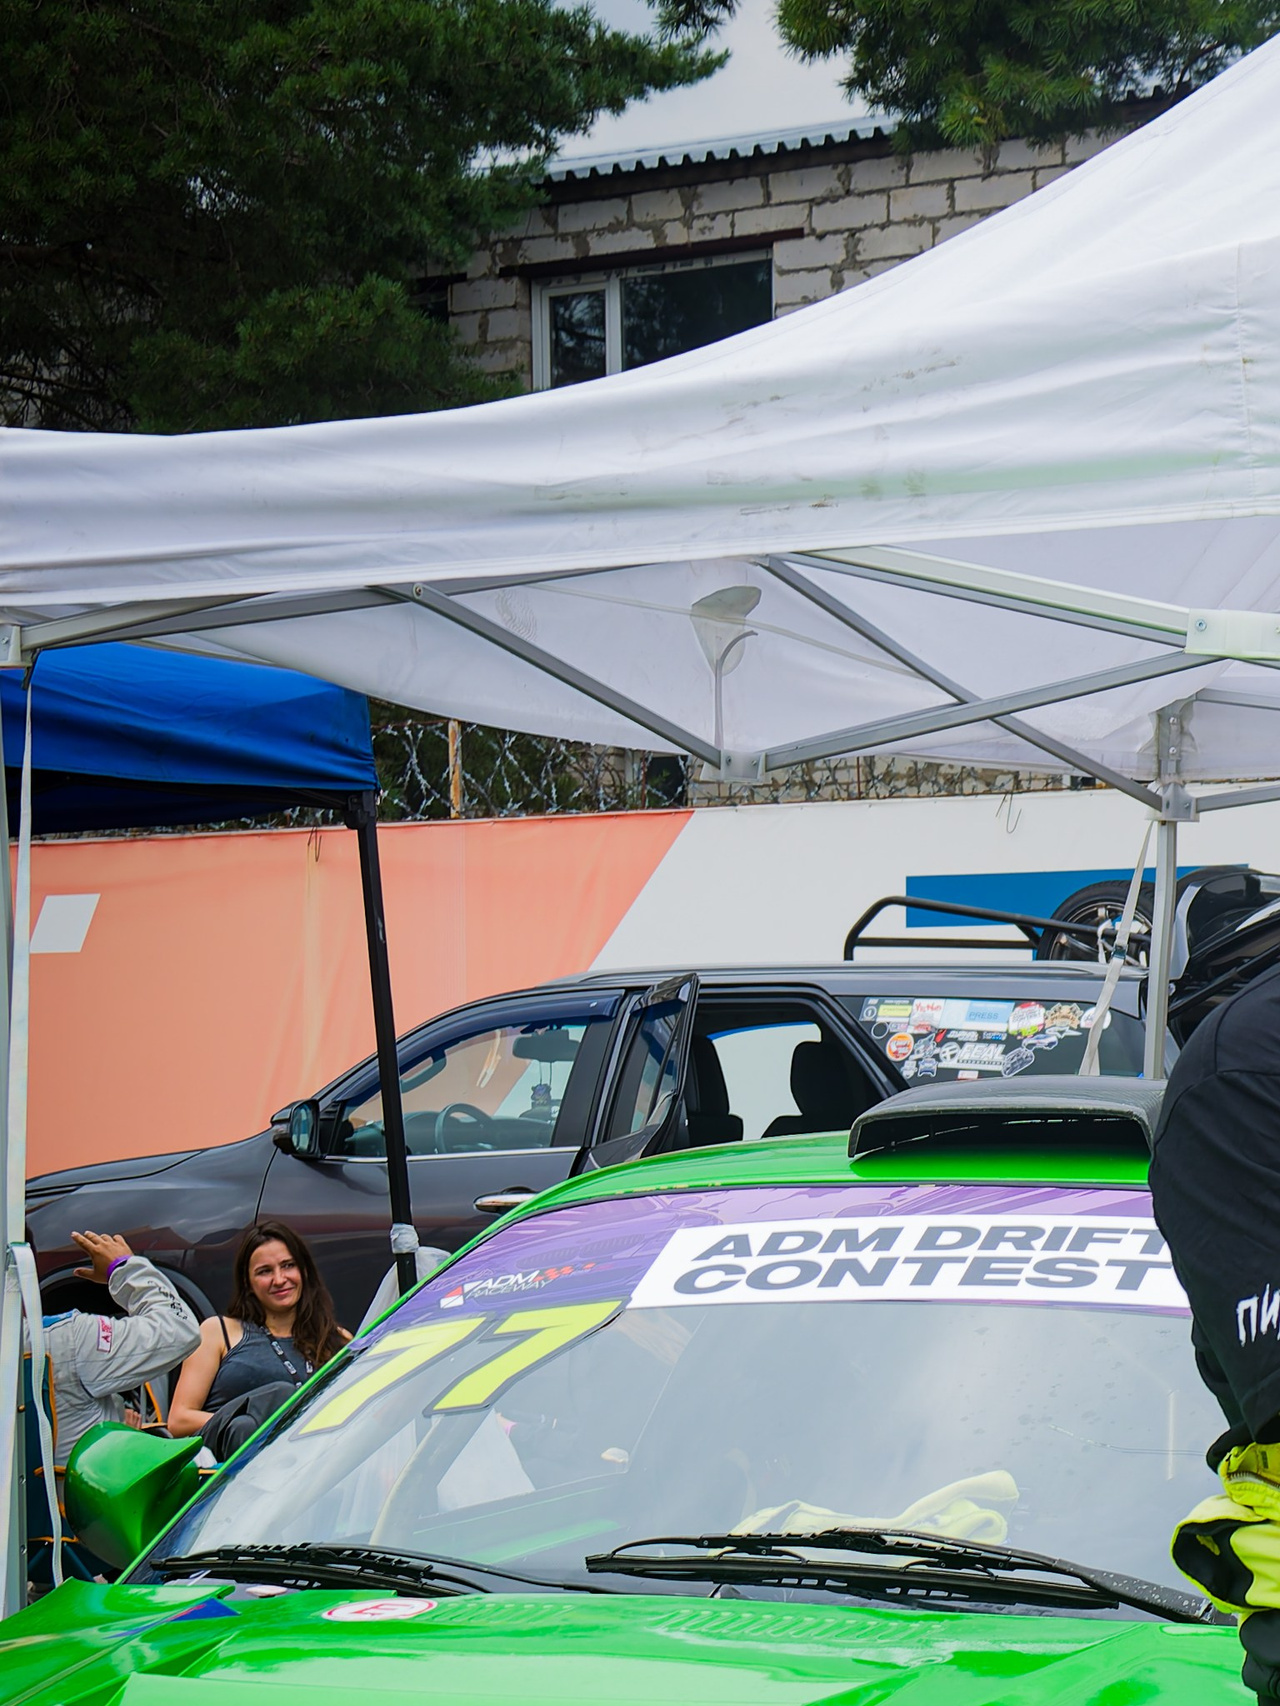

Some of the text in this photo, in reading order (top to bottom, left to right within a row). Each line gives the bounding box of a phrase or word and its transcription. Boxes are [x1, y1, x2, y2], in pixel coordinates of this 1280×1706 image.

[968, 1011, 999, 1021] PRESS
[692, 1225, 1172, 1262] ADM DRIFT
[480, 1270, 541, 1292] ADM
[672, 1255, 1174, 1296] CONTEST
[294, 1299, 625, 1439] 77
